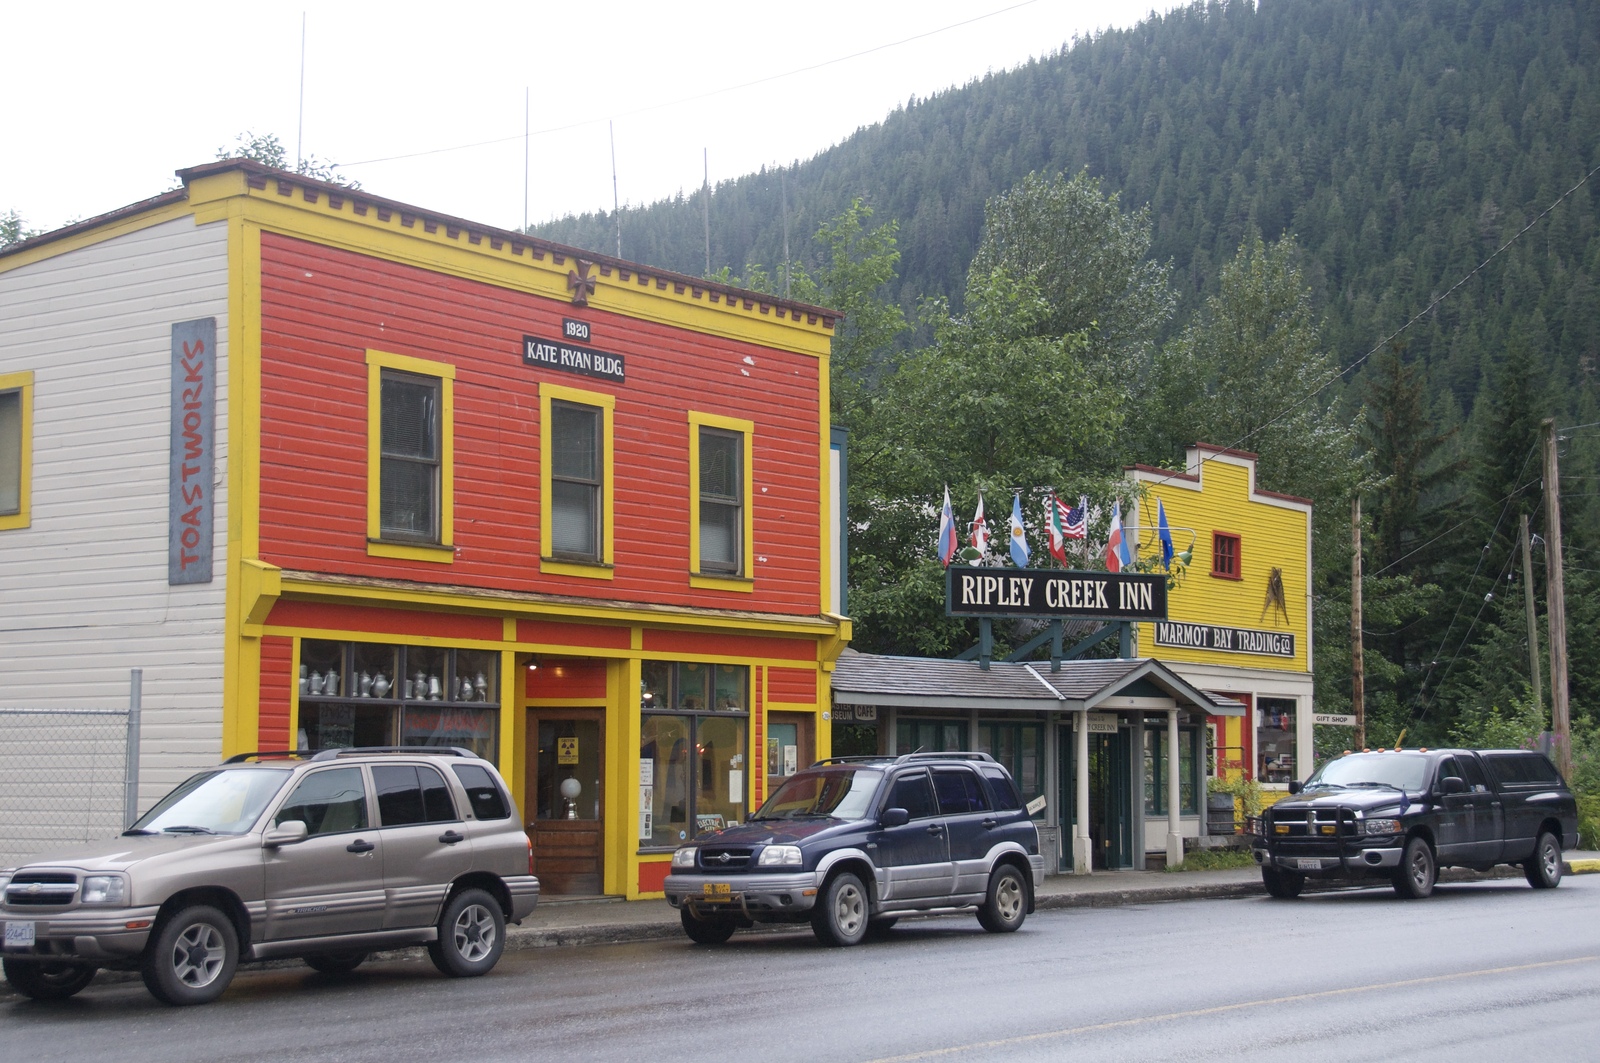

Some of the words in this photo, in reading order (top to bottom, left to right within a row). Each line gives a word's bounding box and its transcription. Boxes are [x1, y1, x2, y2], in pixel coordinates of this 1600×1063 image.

[565, 322, 588, 339] 1920
[527, 342, 558, 364] KATE
[560, 348, 591, 370] RYAN
[594, 355, 625, 377] BLDG.
[179, 338, 205, 570] TOASTWORKS
[962, 575, 1034, 607] RIPLEY
[1046, 579, 1108, 610] CREEK
[1119, 582, 1153, 611] INN
[1159, 623, 1208, 646] MARMOT
[1213, 628, 1232, 649] BAY
[1237, 631, 1280, 653] TRADING
[831, 711, 853, 720] USEUM
[857, 705, 874, 718] CAFE
